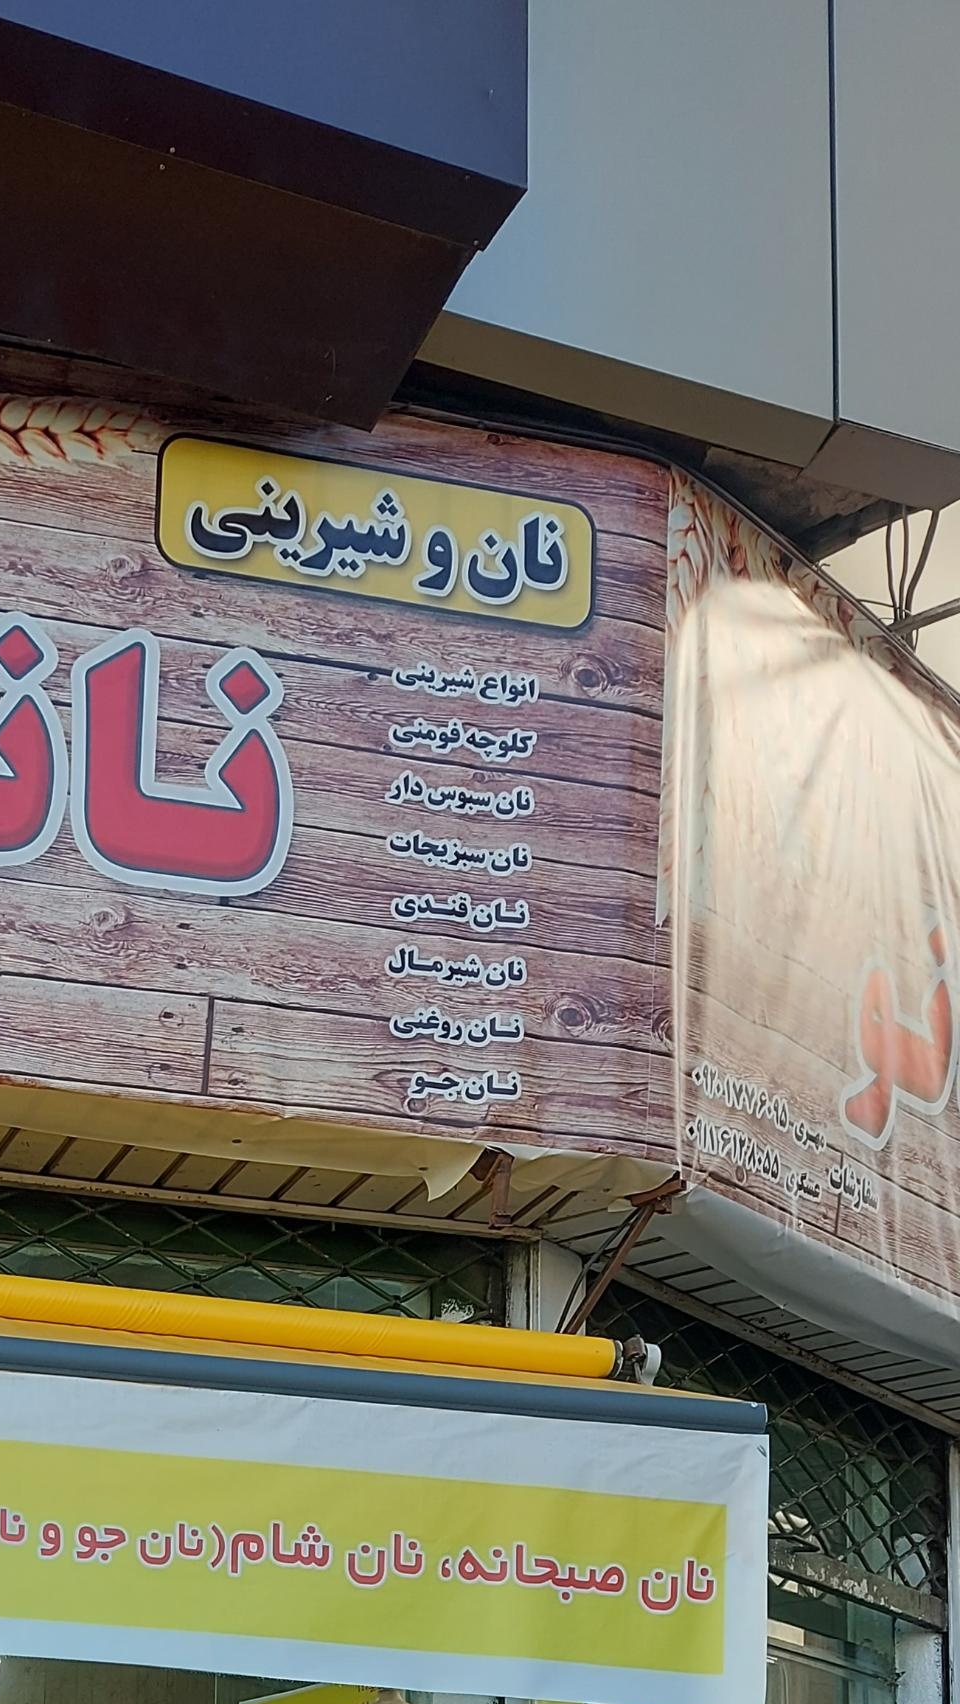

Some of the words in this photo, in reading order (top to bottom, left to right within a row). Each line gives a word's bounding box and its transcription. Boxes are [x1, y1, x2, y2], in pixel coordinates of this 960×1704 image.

[189, 480, 408, 573] شیرینی
[417, 530, 453, 592] و
[467, 515, 565, 601] نان
[394, 664, 476, 693] شیرینی
[478, 673, 537, 701] انواع
[391, 720, 462, 750] فومنی
[465, 731, 534, 759] کلوچه
[389, 774, 424, 800] دار
[427, 787, 491, 811] سبوس
[495, 789, 531, 816] نان
[389, 833, 486, 867] سبزیجات
[490, 846, 530, 873] نان
[394, 895, 469, 919] قندی
[473, 902, 526, 928] نان
[388, 946, 481, 982] شیرمال
[485, 959, 525, 986] نان
[392, 1009, 463, 1040] روغنی
[467, 1016, 521, 1043] نان
[843, 925, 953, 1139] نو
[410, 1074, 460, 1099] جو
[464, 1073, 519, 1100] نان
[39, 1521, 61, 1557] و
[75, 1525, 127, 1562] جو
[347, 1533, 424, 1585] نان
[440, 1543, 625, 1602] صبحانه،
[640, 1559, 716, 1612] نان
